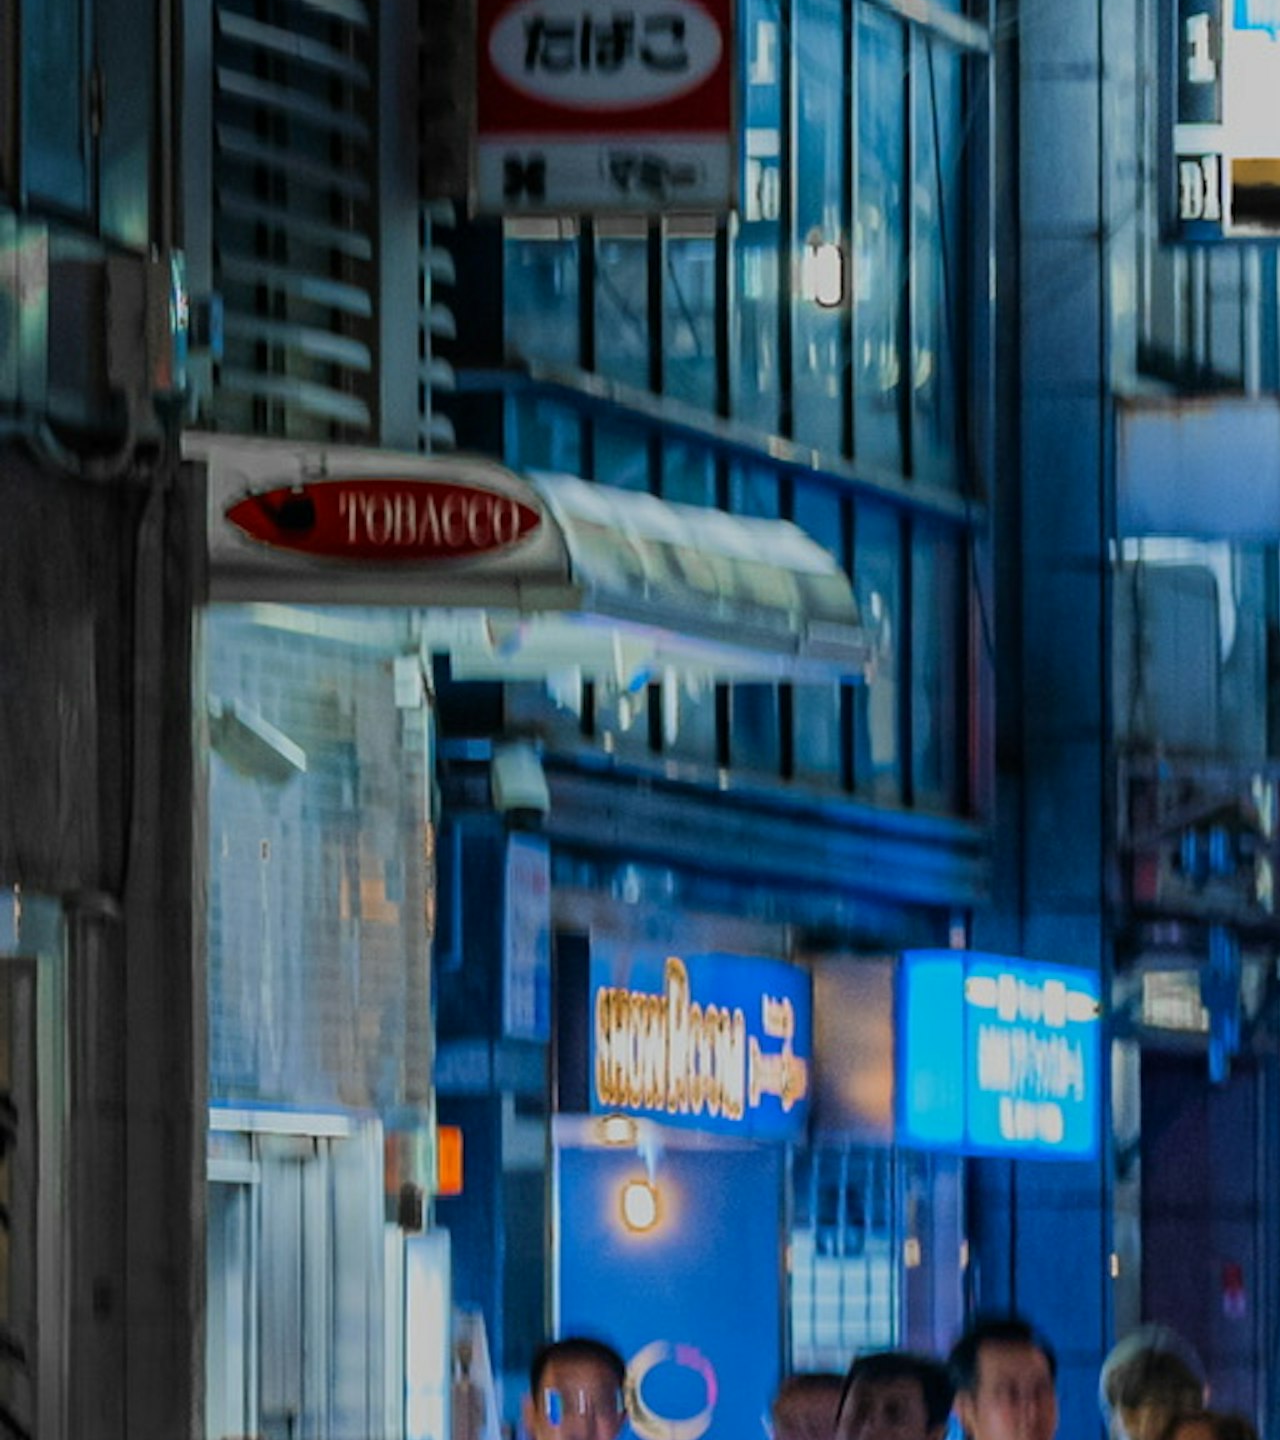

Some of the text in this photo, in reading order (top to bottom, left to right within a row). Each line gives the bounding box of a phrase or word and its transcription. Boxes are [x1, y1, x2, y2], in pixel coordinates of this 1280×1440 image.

[521, 11, 690, 75] たばこ
[1186, 13, 1216, 83] 1
[1179, 155, 1220, 221] B1
[338, 491, 520, 545] TOBACCO
